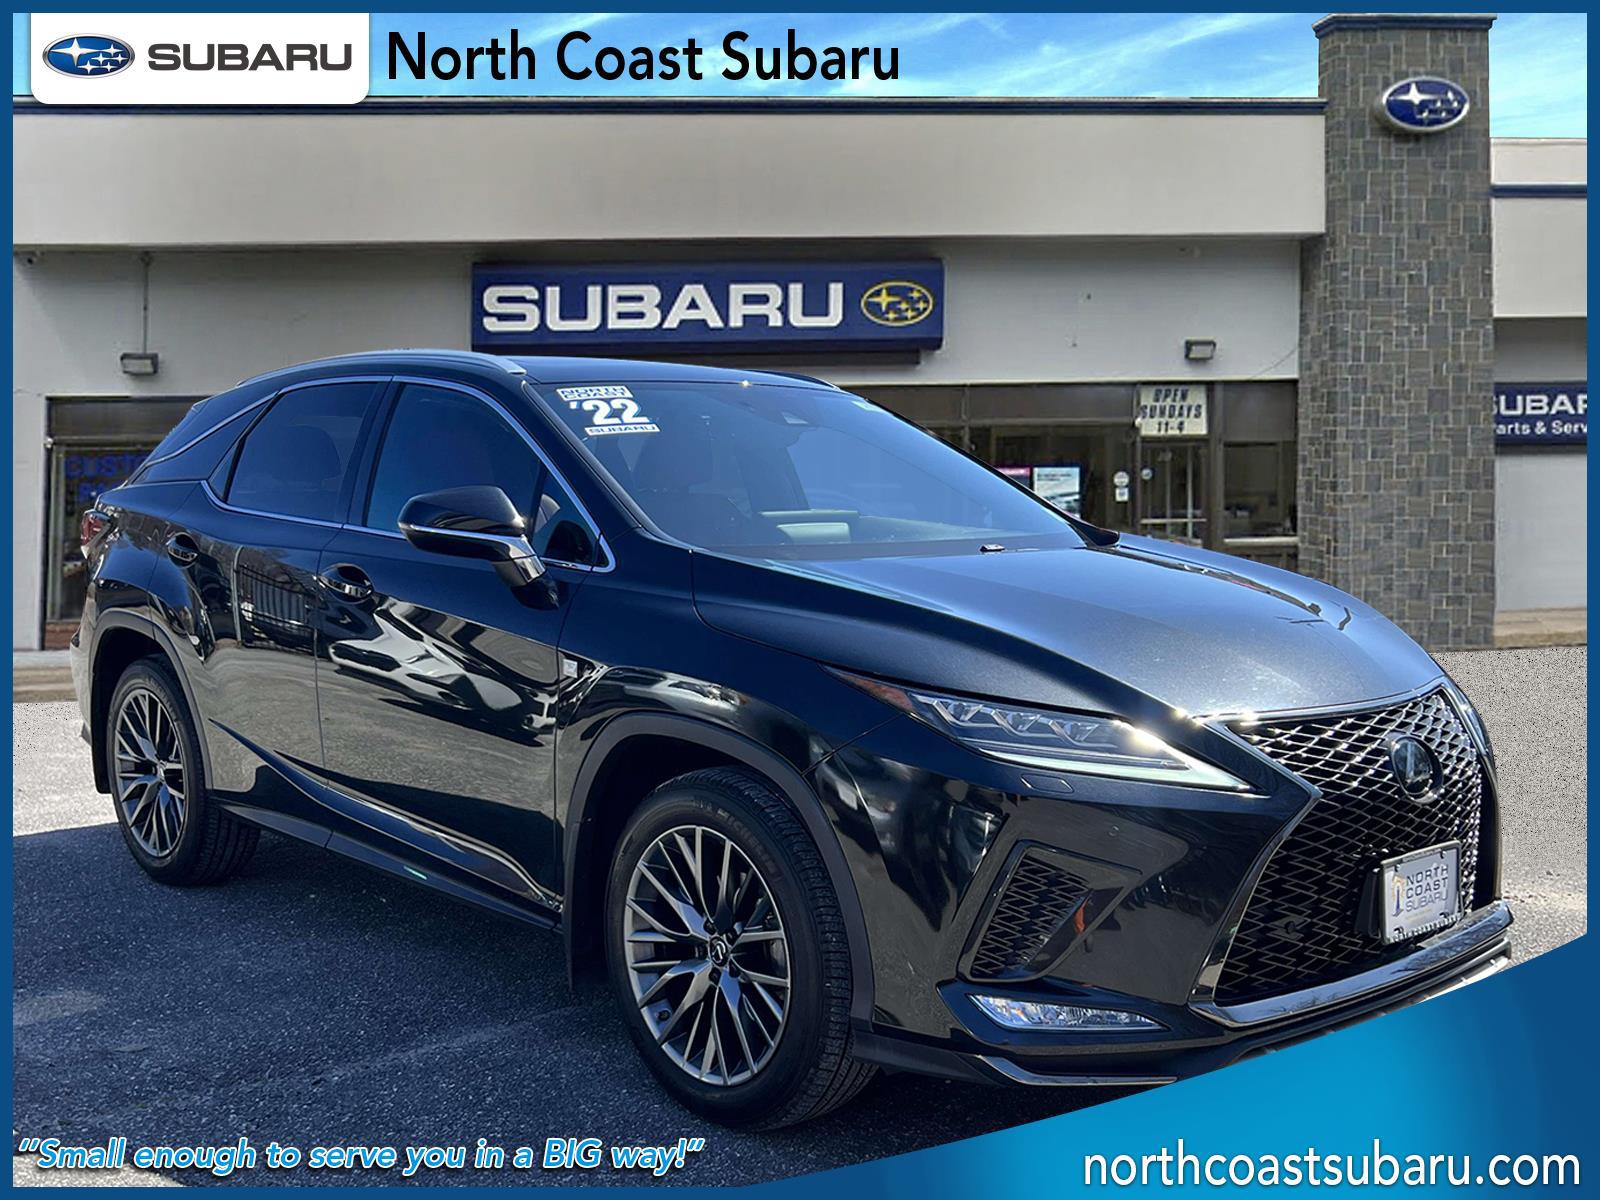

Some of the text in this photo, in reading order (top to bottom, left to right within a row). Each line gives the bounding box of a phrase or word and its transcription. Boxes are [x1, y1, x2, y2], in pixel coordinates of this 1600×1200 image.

[482, 282, 844, 332] SUBARU
[1152, 388, 1189, 403] OPEN
[1493, 393, 1587, 415] UBA
[569, 398, 650, 425] '22
[1140, 404, 1203, 419] SUNDAYS
[588, 425, 657, 434] SUBARU
[1157, 420, 1185, 433] 11-4
[1493, 421, 1531, 435] arts
[1534, 421, 1547, 435] &
[1406, 863, 1449, 886] NORTH
[1406, 877, 1449, 899] COAST
[1405, 889, 1449, 912] SUBARU
